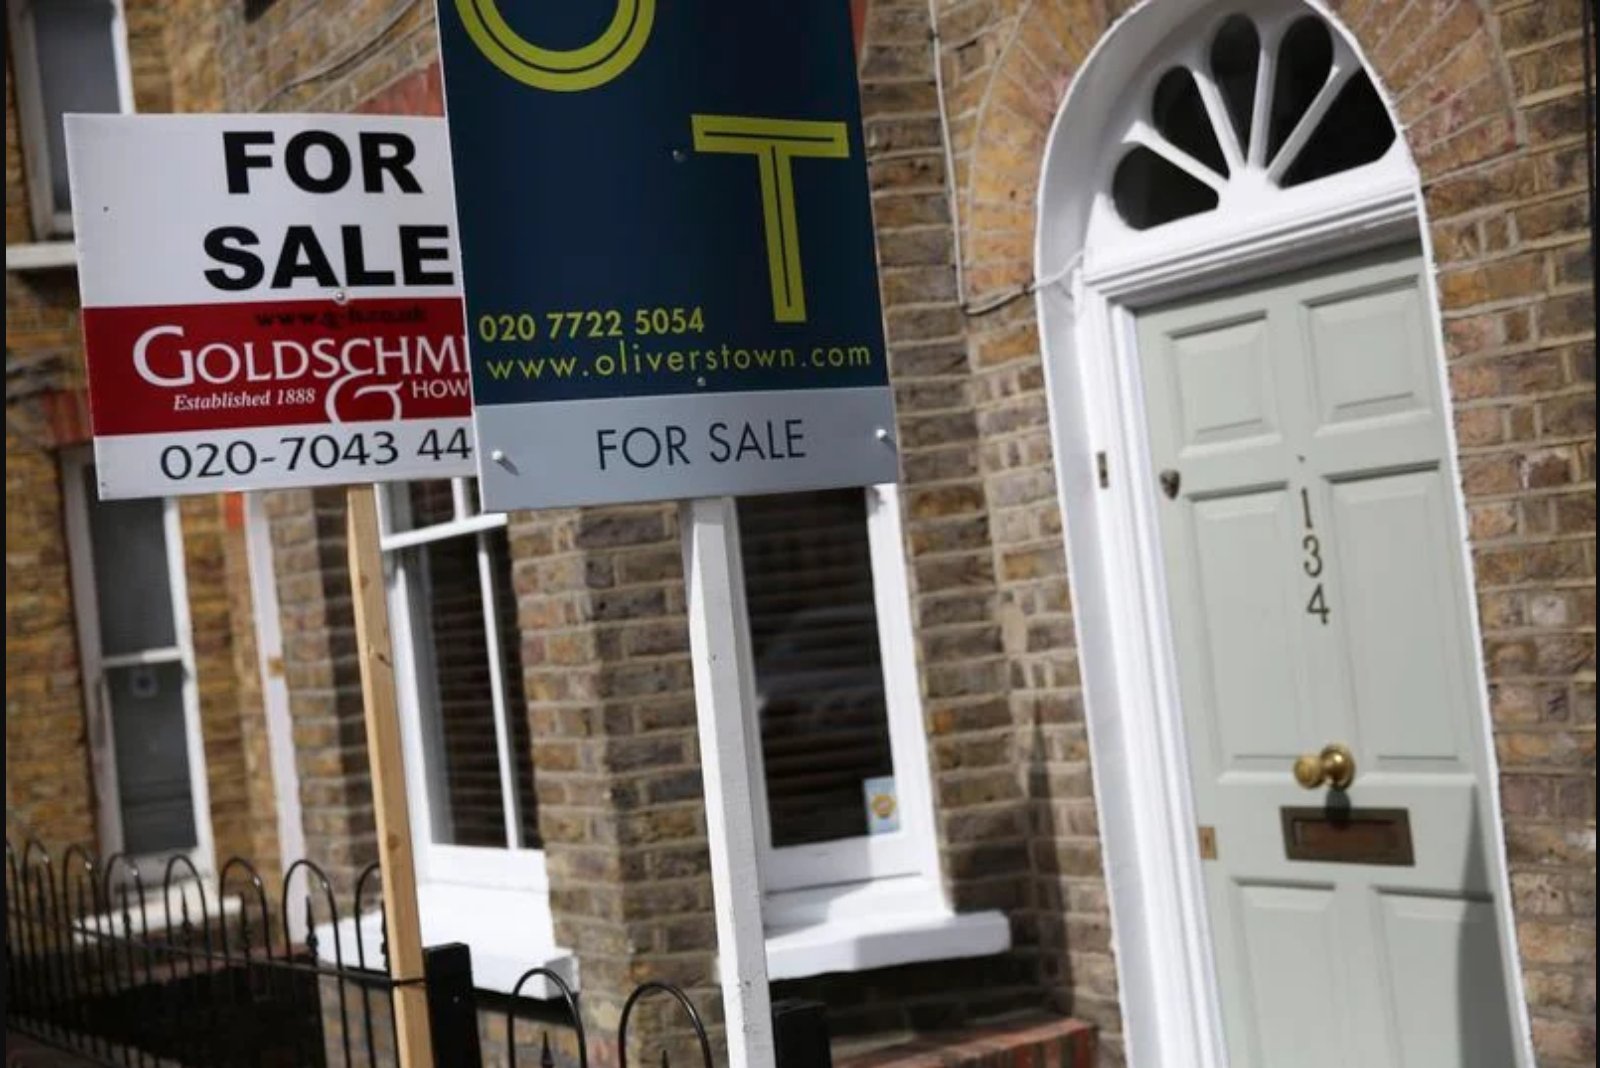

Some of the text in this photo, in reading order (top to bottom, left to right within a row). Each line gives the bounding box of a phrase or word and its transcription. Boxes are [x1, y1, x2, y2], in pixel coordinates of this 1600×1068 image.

[222, 130, 423, 194] FOR
[691, 114, 849, 323] T
[203, 225, 454, 291] SALE
[478, 306, 705, 342] 020 7722 5054
[486, 341, 871, 379] www.oliverstown.com
[173, 387, 316, 412] Established 1888
[412, 378, 469, 399] HOW
[160, 427, 472, 480] 020-7043 44
[597, 419, 807, 470] FOR SALE
